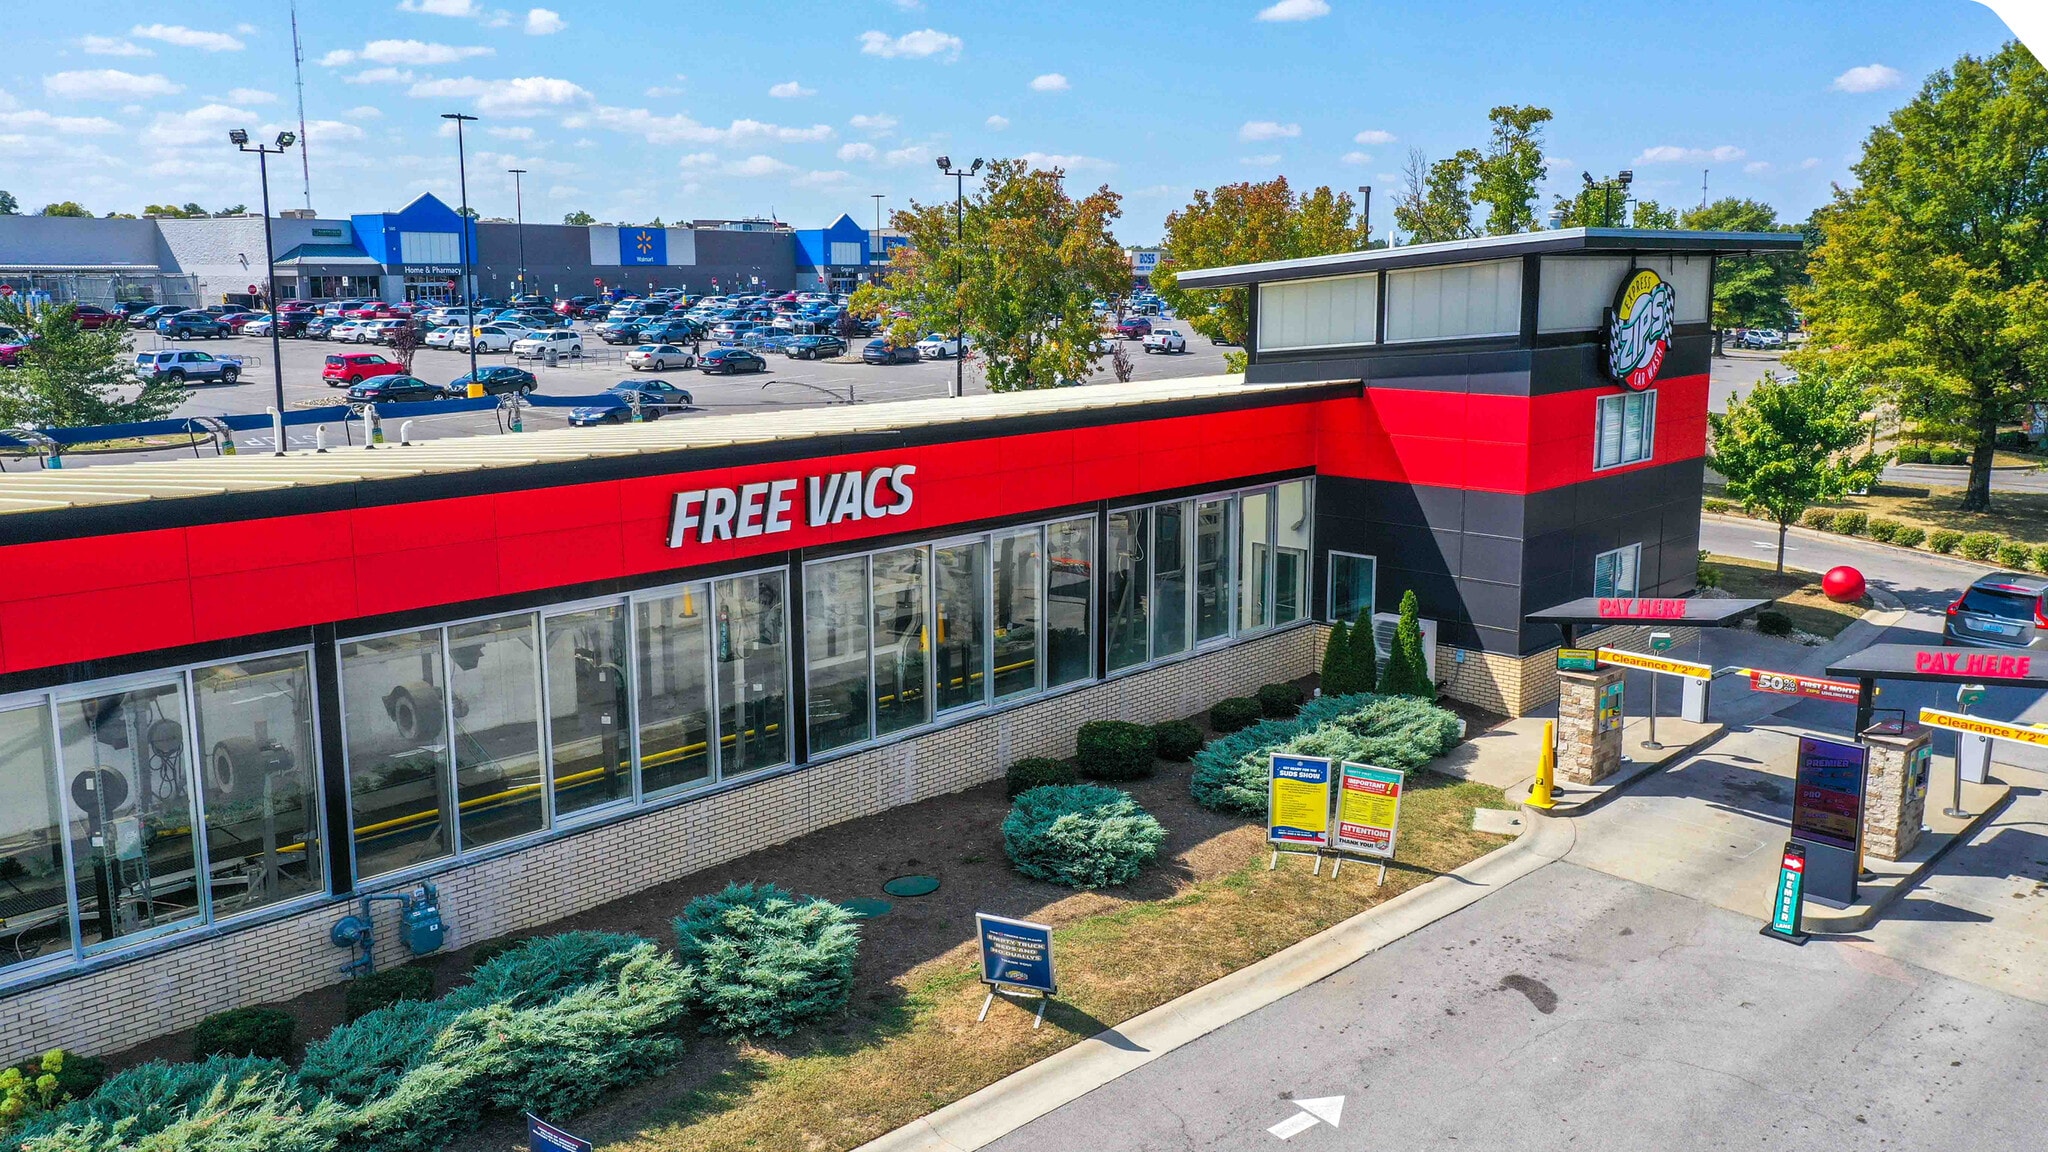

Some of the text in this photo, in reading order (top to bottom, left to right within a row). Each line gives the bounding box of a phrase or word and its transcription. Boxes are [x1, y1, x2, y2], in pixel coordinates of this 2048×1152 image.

[1139, 254, 1155, 264] ROSS
[404, 266, 461, 276] Home & Pharmacy
[1625, 276, 1652, 310] EXPRESS
[1620, 290, 1666, 370] ZIPS
[1633, 346, 1663, 386] CAR WASH
[667, 464, 917, 549] FREE VACS
[1599, 598, 1687, 619] PAY HERE
[1612, 653, 1668, 670] Clearance
[1916, 652, 2032, 678] PAY HERE
[1758, 674, 1796, 690] 50%
[1800, 681, 1821, 690] FIRST
[1821, 691, 1854, 699] UNLIMITED
[1937, 715, 2010, 737] Clearance
[1806, 759, 1849, 768] PREMIER
[1279, 770, 1298, 778] SUDS
[1341, 824, 1389, 838] ATTENTION!
[1339, 838, 1359, 846] THANK
[1781, 871, 1796, 922] MEMBER
[988, 934, 1045, 949] EMPTY TRUCK
[995, 943, 1017, 951] BEDS
[1005, 950, 1041, 961] DUALLYS
